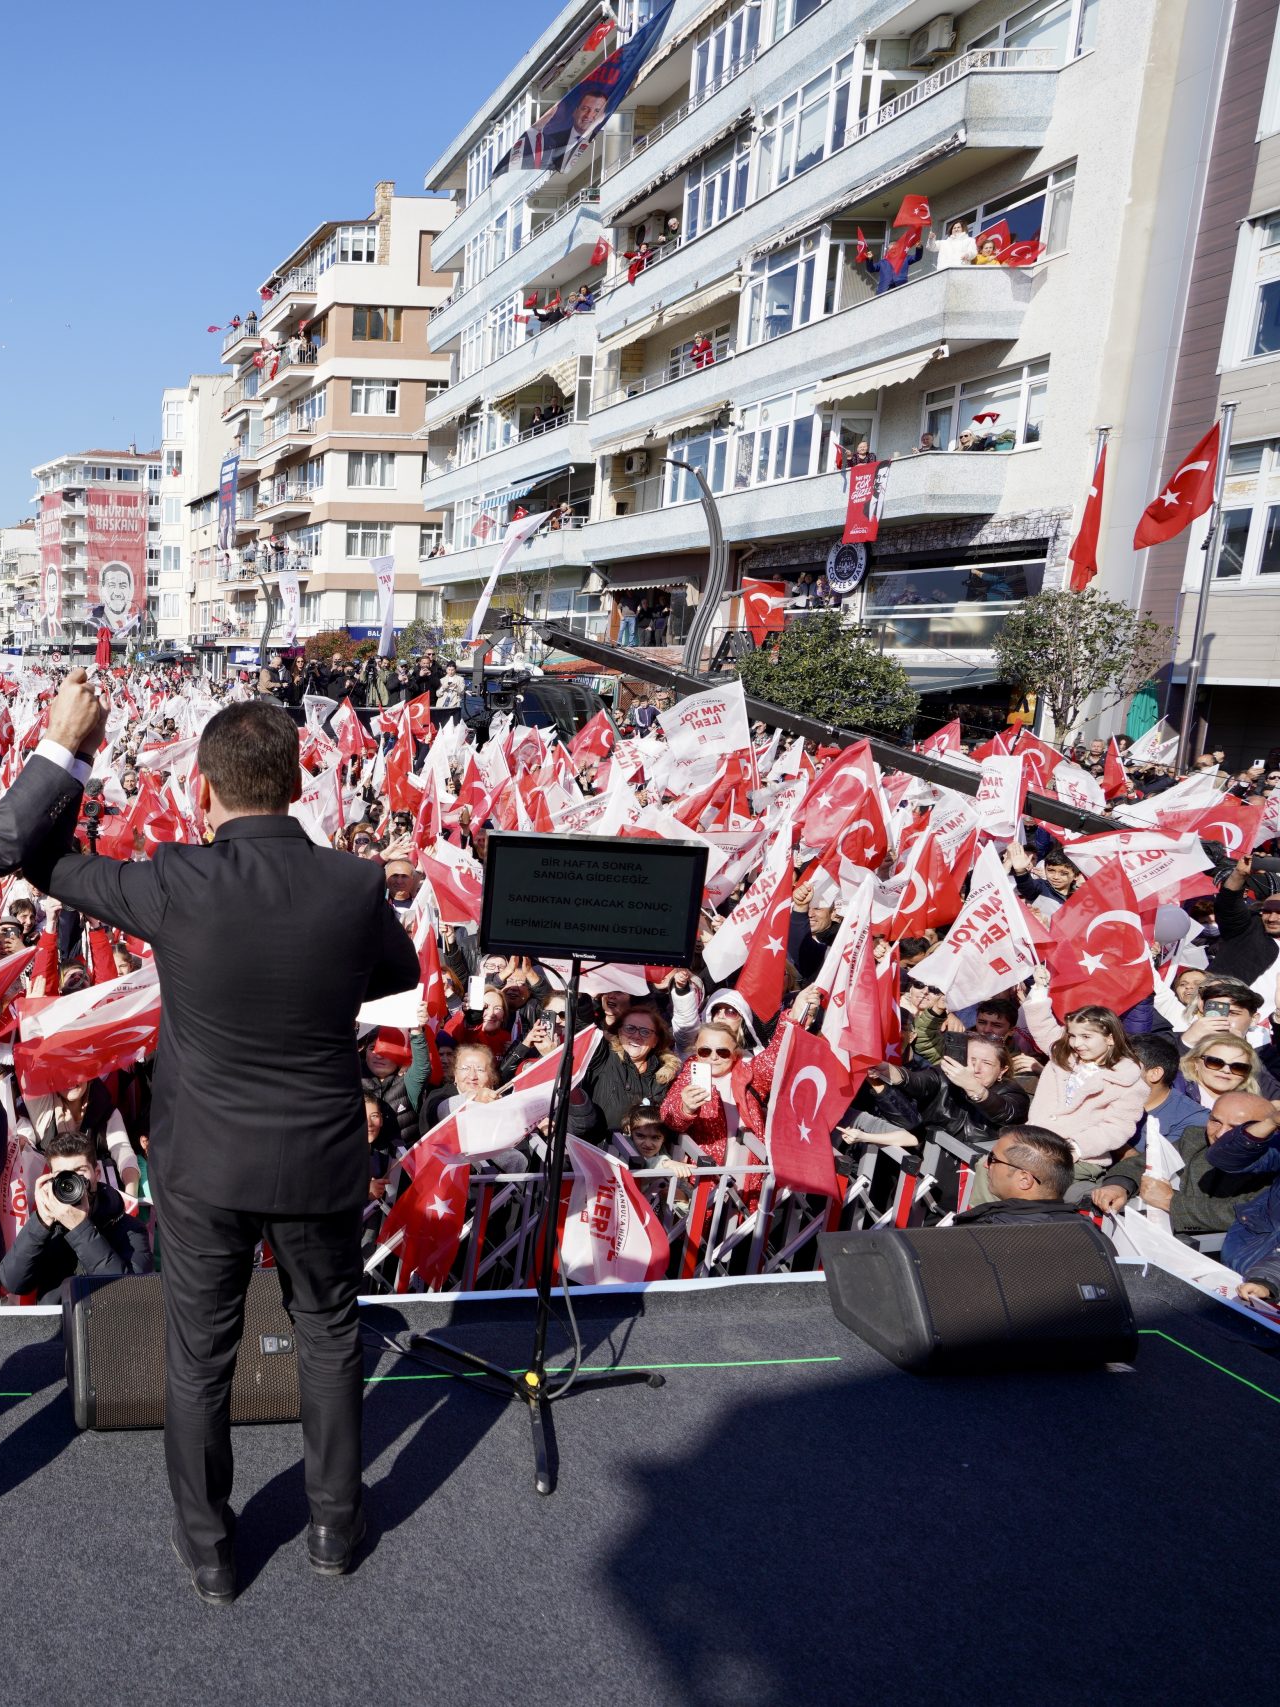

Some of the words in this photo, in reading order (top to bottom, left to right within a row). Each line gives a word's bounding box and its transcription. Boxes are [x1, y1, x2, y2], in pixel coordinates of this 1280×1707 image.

[852, 563, 864, 581] BAR
[541, 856, 560, 867] BİR
[564, 858, 599, 870] HAFTA
[602, 861, 642, 872] SONRA
[534, 869, 583, 881] SANDIĞA
[586, 872, 650, 885] GİDECEĞİZ.
[508, 893, 570, 905] SANDIKTAN
[574, 896, 625, 908] ÇIKACAK
[506, 917, 561, 930] HEPİMİZİN
[564, 921, 609, 934] BAŞININ
[612, 924, 670, 938] ÜSTÜNDE.
[571, 952, 597, 960] ViewSonic
